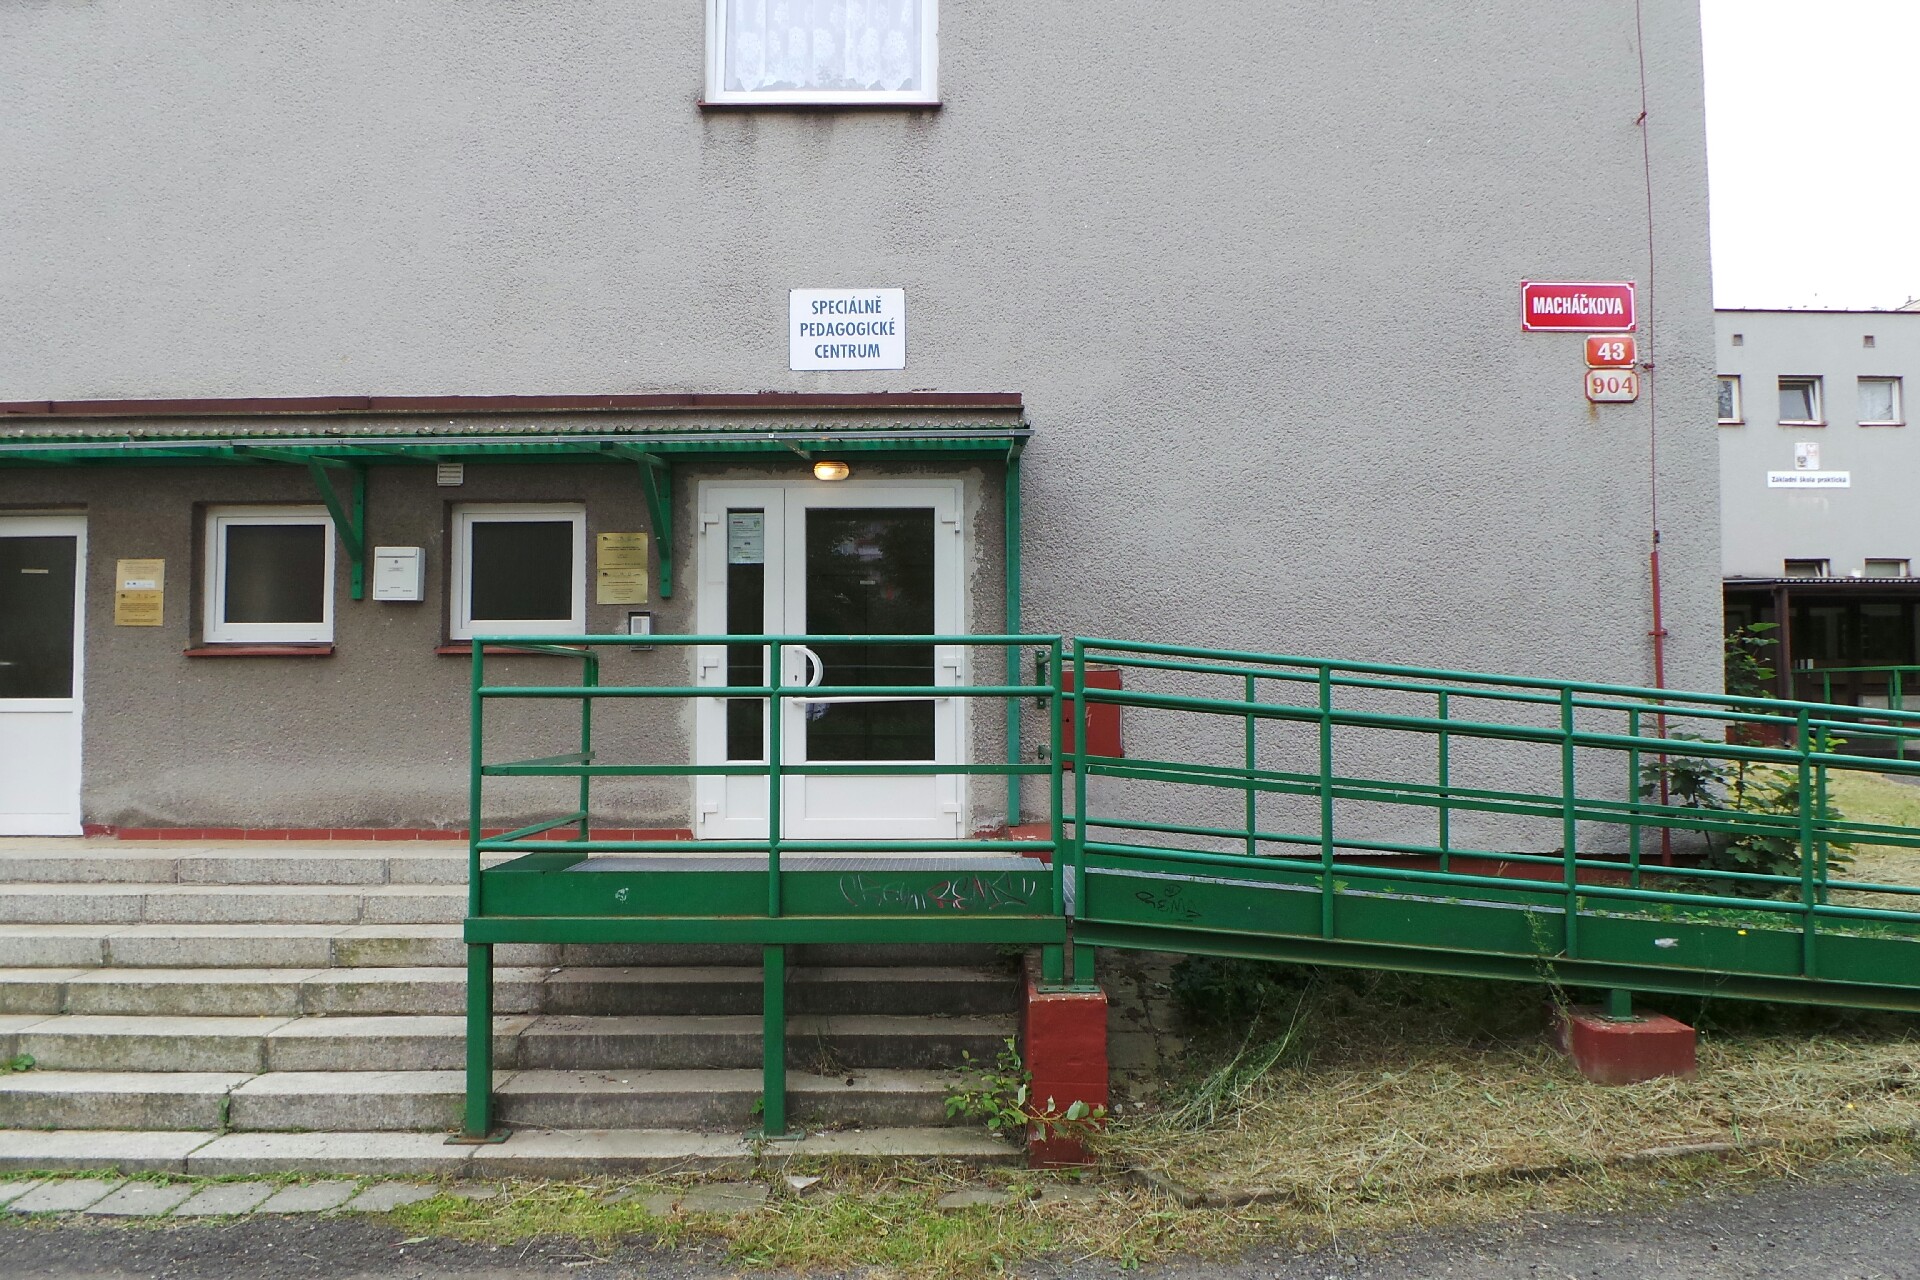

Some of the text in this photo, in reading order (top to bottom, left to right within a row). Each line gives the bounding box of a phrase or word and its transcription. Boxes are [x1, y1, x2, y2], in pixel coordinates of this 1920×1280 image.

[811, 295, 882, 314] SPECIÁLNĚ
[1532, 293, 1624, 315] MACHÁČKOVA
[800, 317, 896, 337] PEDAGOGICKÉ
[814, 343, 881, 359] CENTRUM
[1597, 342, 1626, 361] 43
[1592, 376, 1634, 394] 904
